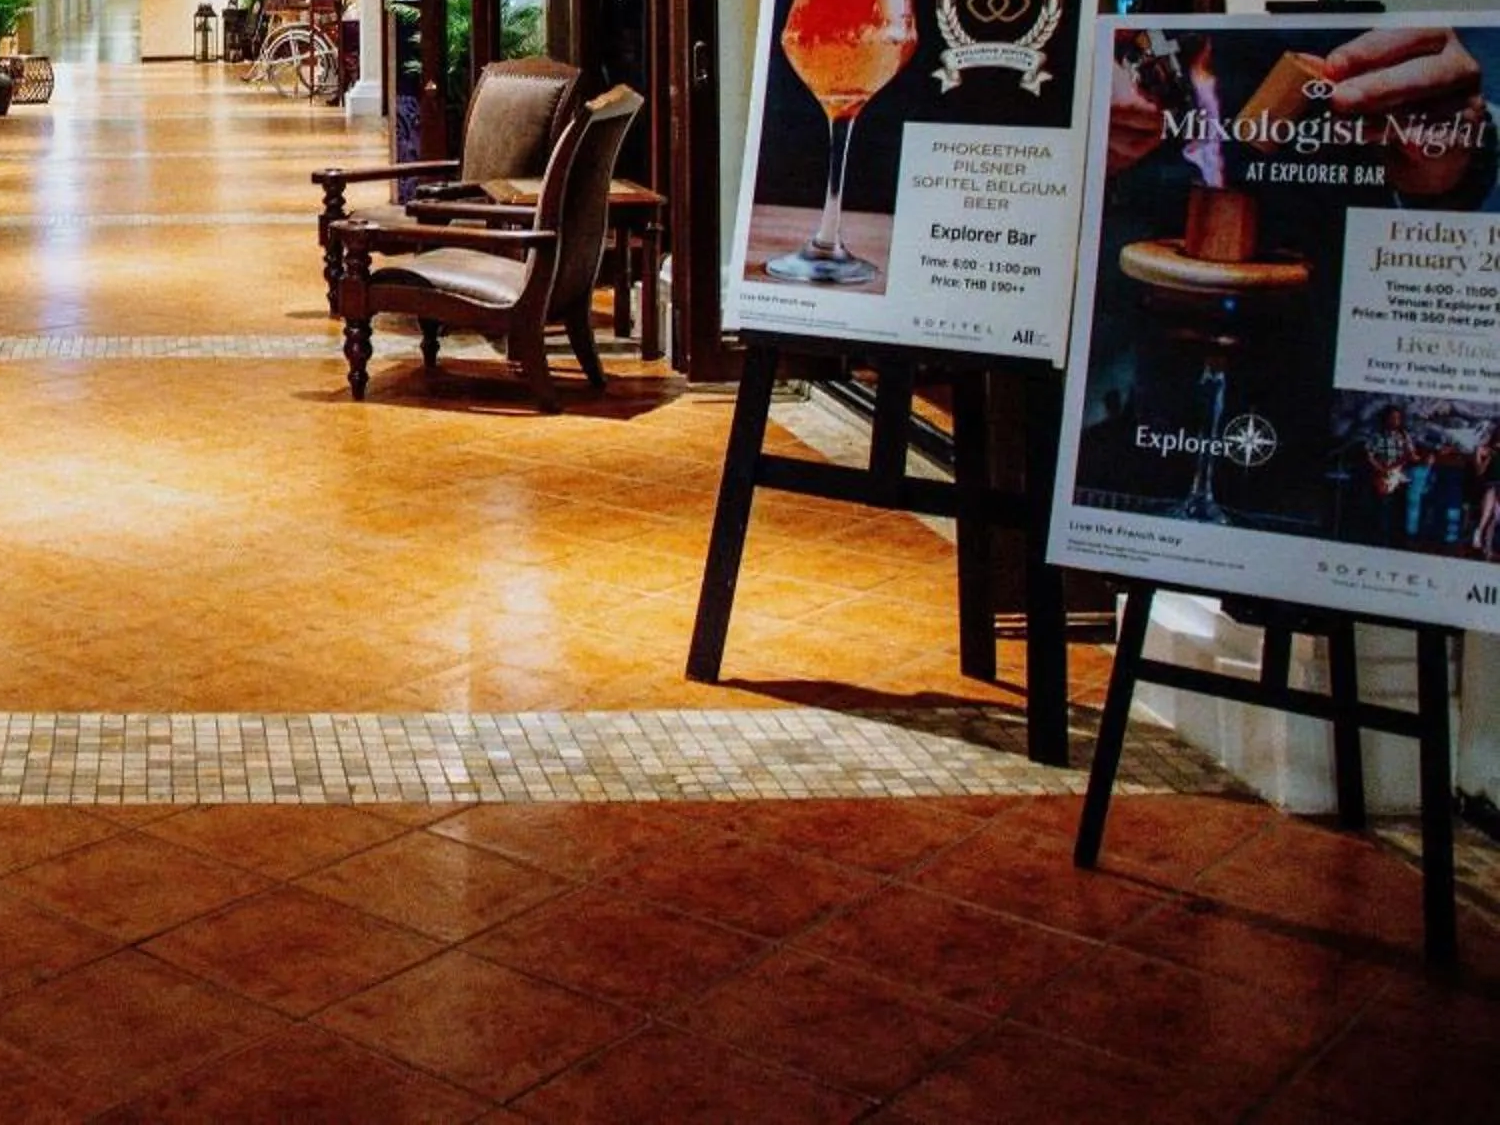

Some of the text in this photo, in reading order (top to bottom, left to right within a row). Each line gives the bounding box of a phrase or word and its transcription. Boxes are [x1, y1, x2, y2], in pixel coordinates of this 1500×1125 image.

[1160, 108, 1486, 157] Mixologist Night
[932, 141, 1052, 159] PHOKEETHRA
[953, 160, 1027, 176] PILSNER
[1246, 162, 1386, 186] AT EXPLORER BAR
[912, 175, 1067, 196] SOFITEL BELGIUM
[963, 196, 1010, 210] BEER
[931, 224, 1037, 246] Explorer Bar
[921, 255, 948, 268] Time:
[1022, 266, 1041, 276] pm
[1370, 247, 1467, 277] January
[965, 278, 987, 291] THB
[1386, 280, 1421, 293] Time:
[1391, 309, 1417, 322] THB
[1135, 424, 1233, 457] Explorer
[1318, 561, 1440, 589] SOFITEL
